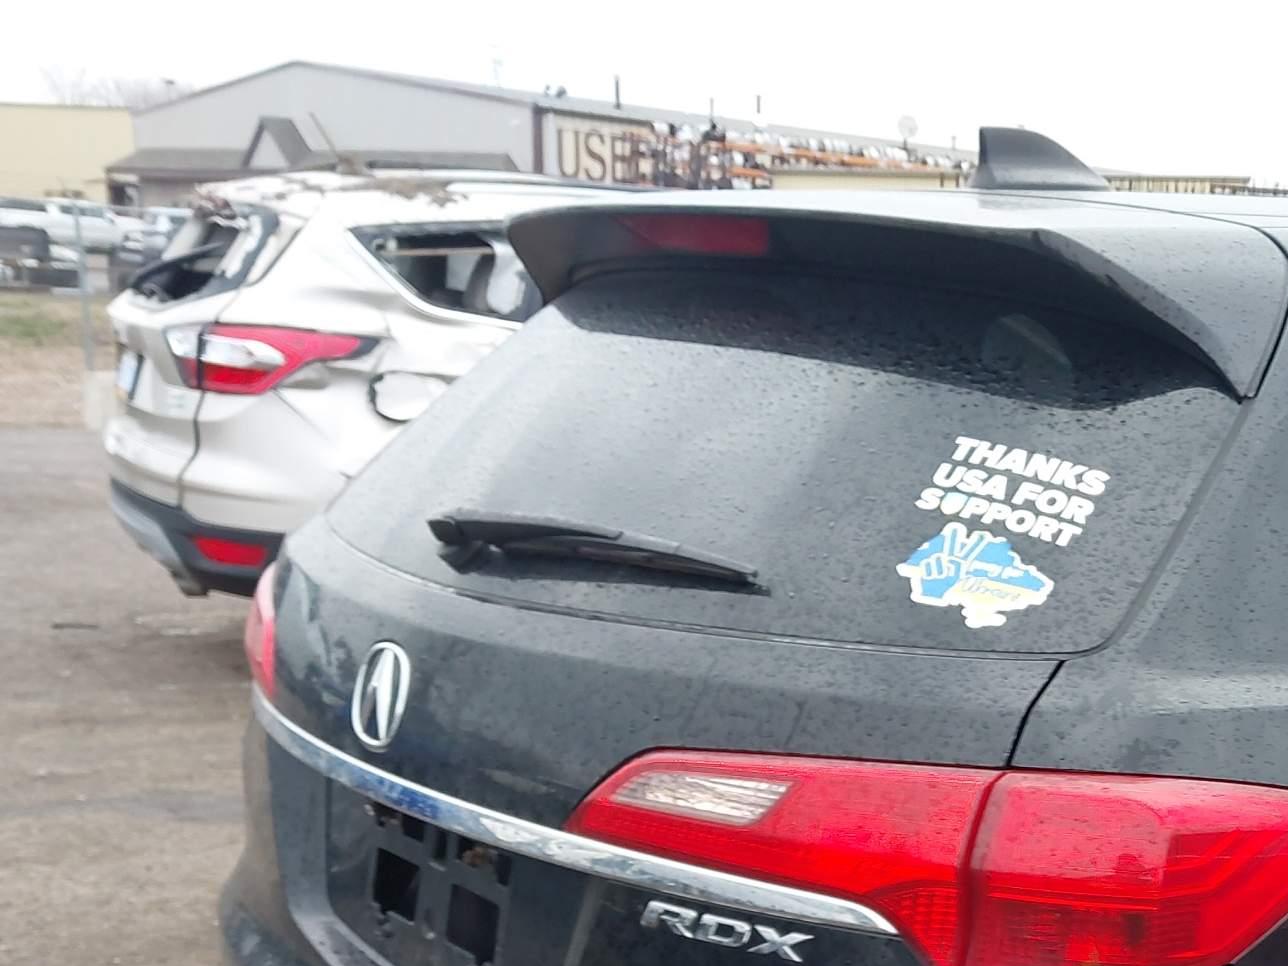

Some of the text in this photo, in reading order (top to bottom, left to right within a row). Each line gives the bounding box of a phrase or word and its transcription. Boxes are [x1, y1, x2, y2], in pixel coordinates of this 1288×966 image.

[557, 128, 656, 184] USE
[932, 463, 1095, 524] USA FOR
[951, 436, 1110, 496] THANKS
[914, 488, 1083, 547] SUPPORT
[640, 900, 815, 962] RDX
